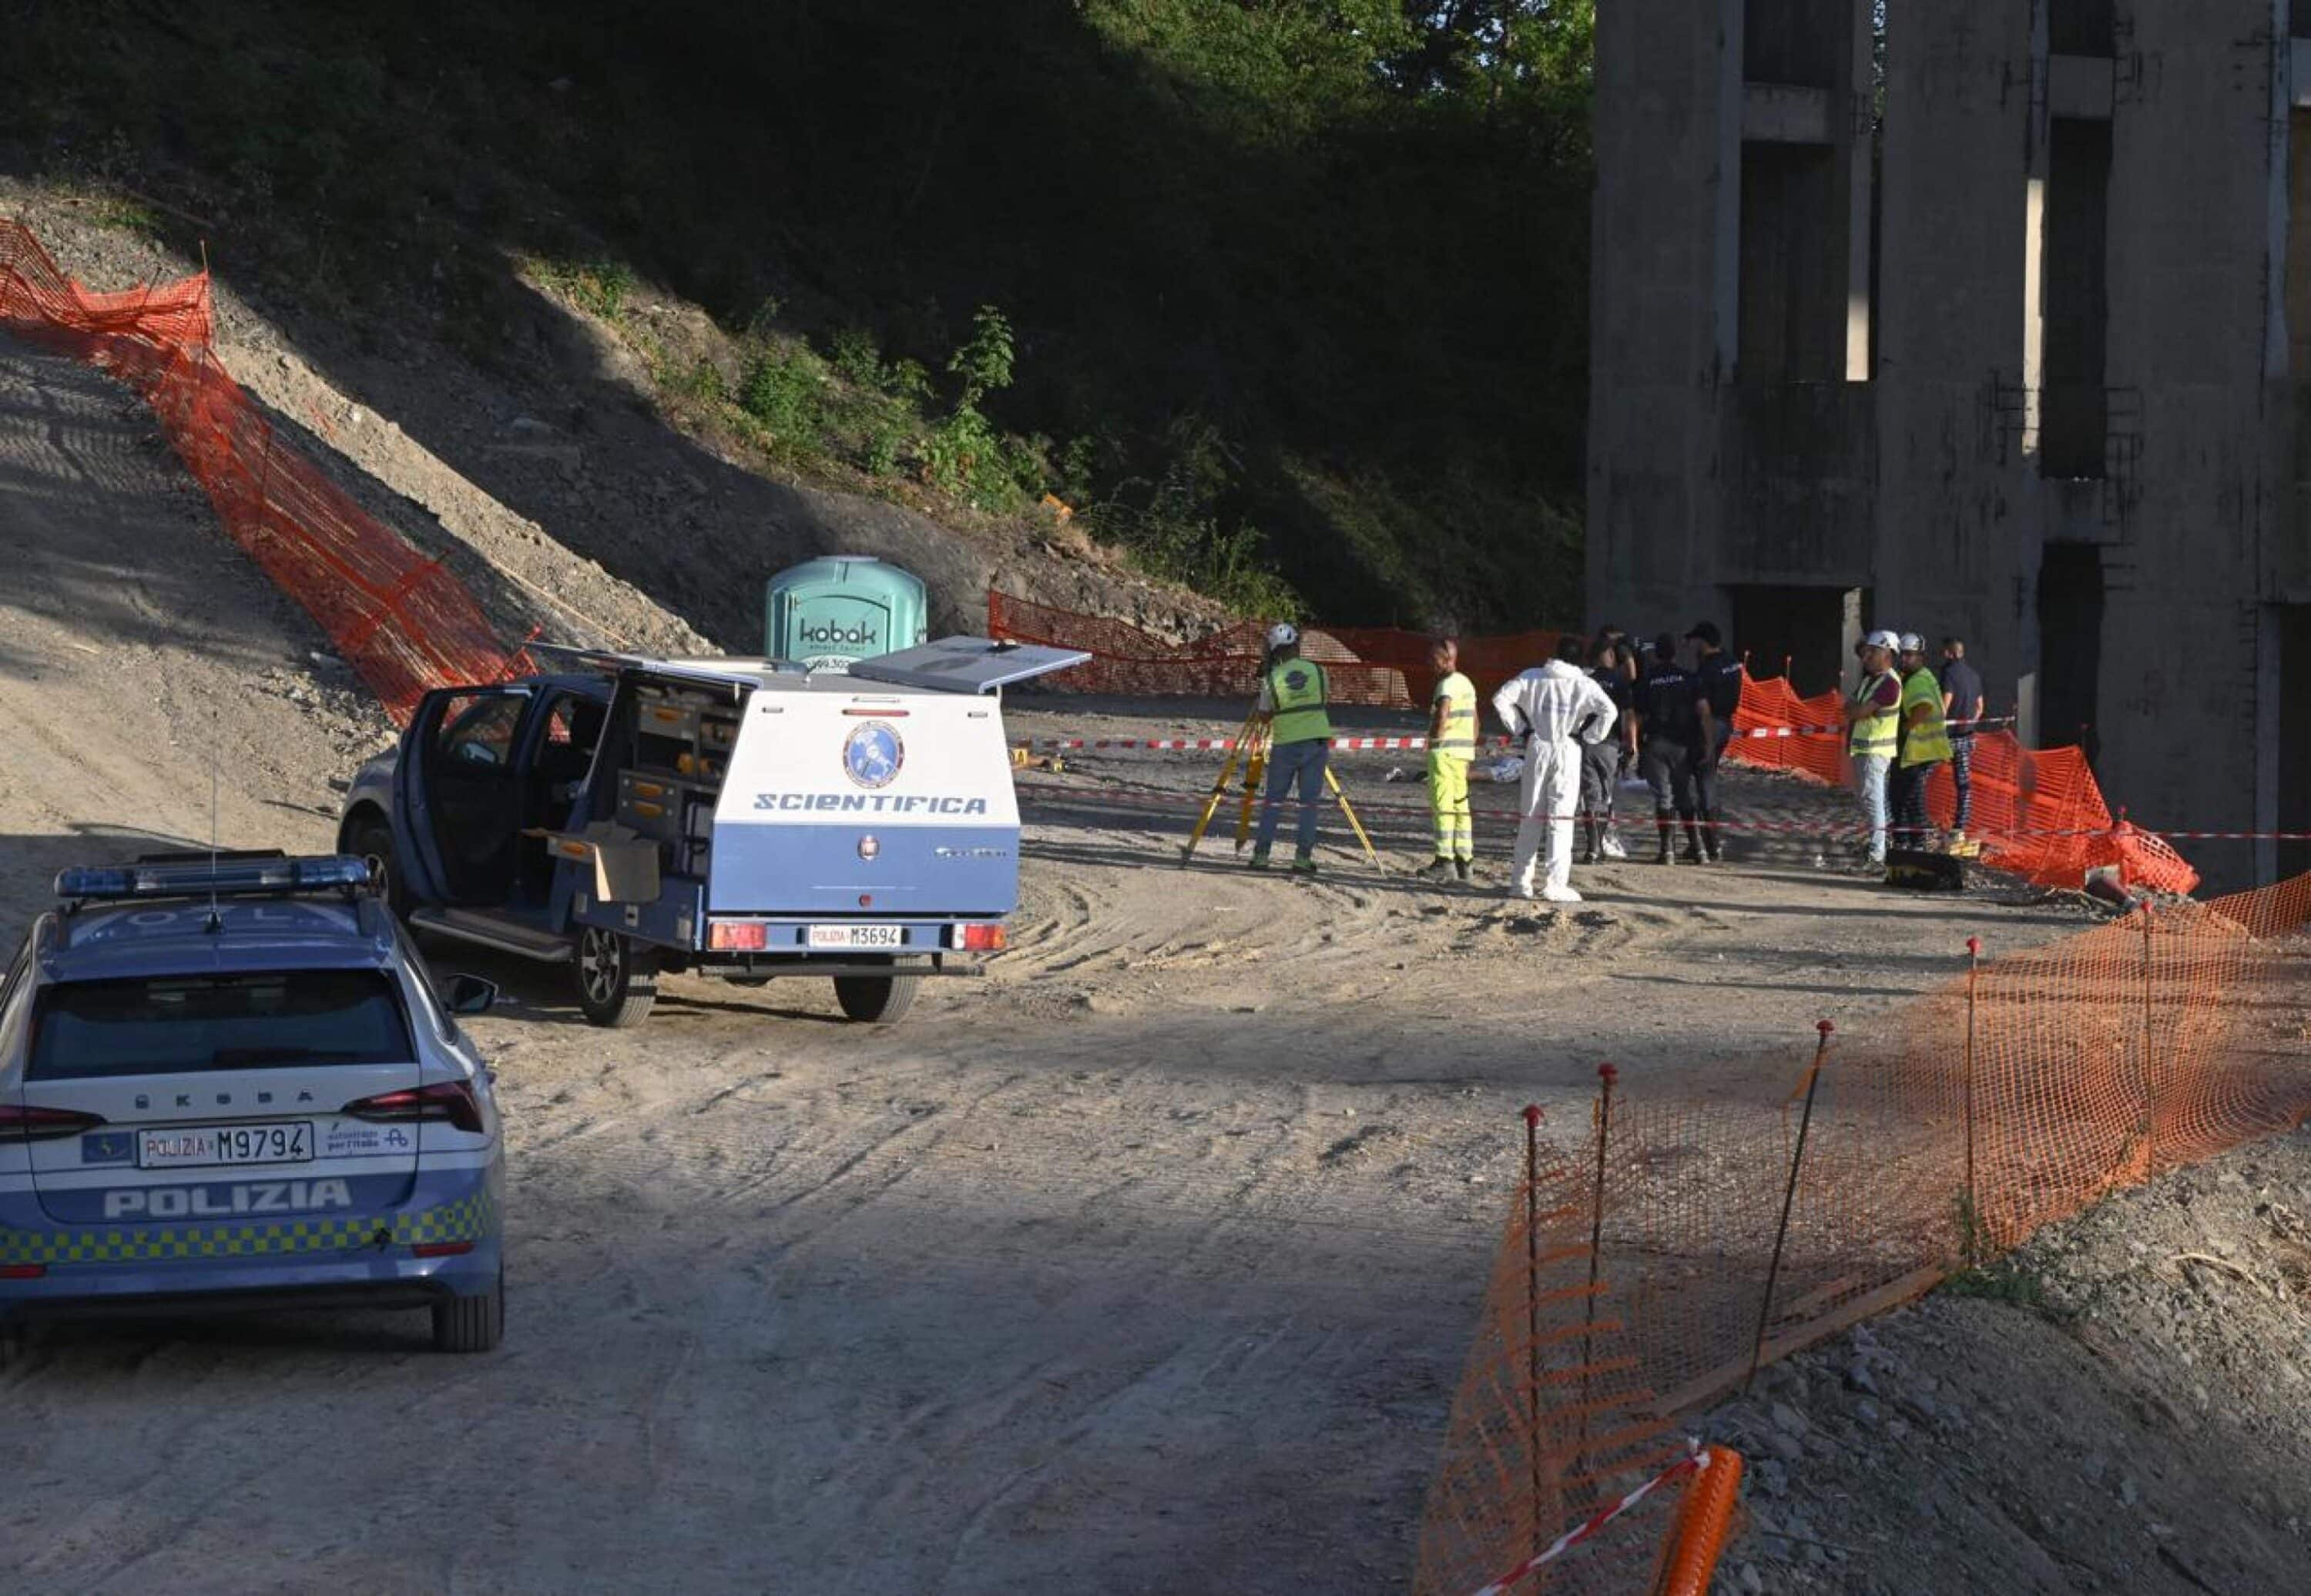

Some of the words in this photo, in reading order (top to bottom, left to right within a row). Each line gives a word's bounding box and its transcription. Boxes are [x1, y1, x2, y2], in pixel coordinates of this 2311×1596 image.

[800, 619, 877, 644] kobak
[812, 929, 846, 942] POLIZIA
[850, 927, 897, 944] M3694
[146, 1137, 206, 1157] POLIZIA
[217, 1128, 304, 1161] M9794
[105, 1179, 352, 1219] POLIZIA
